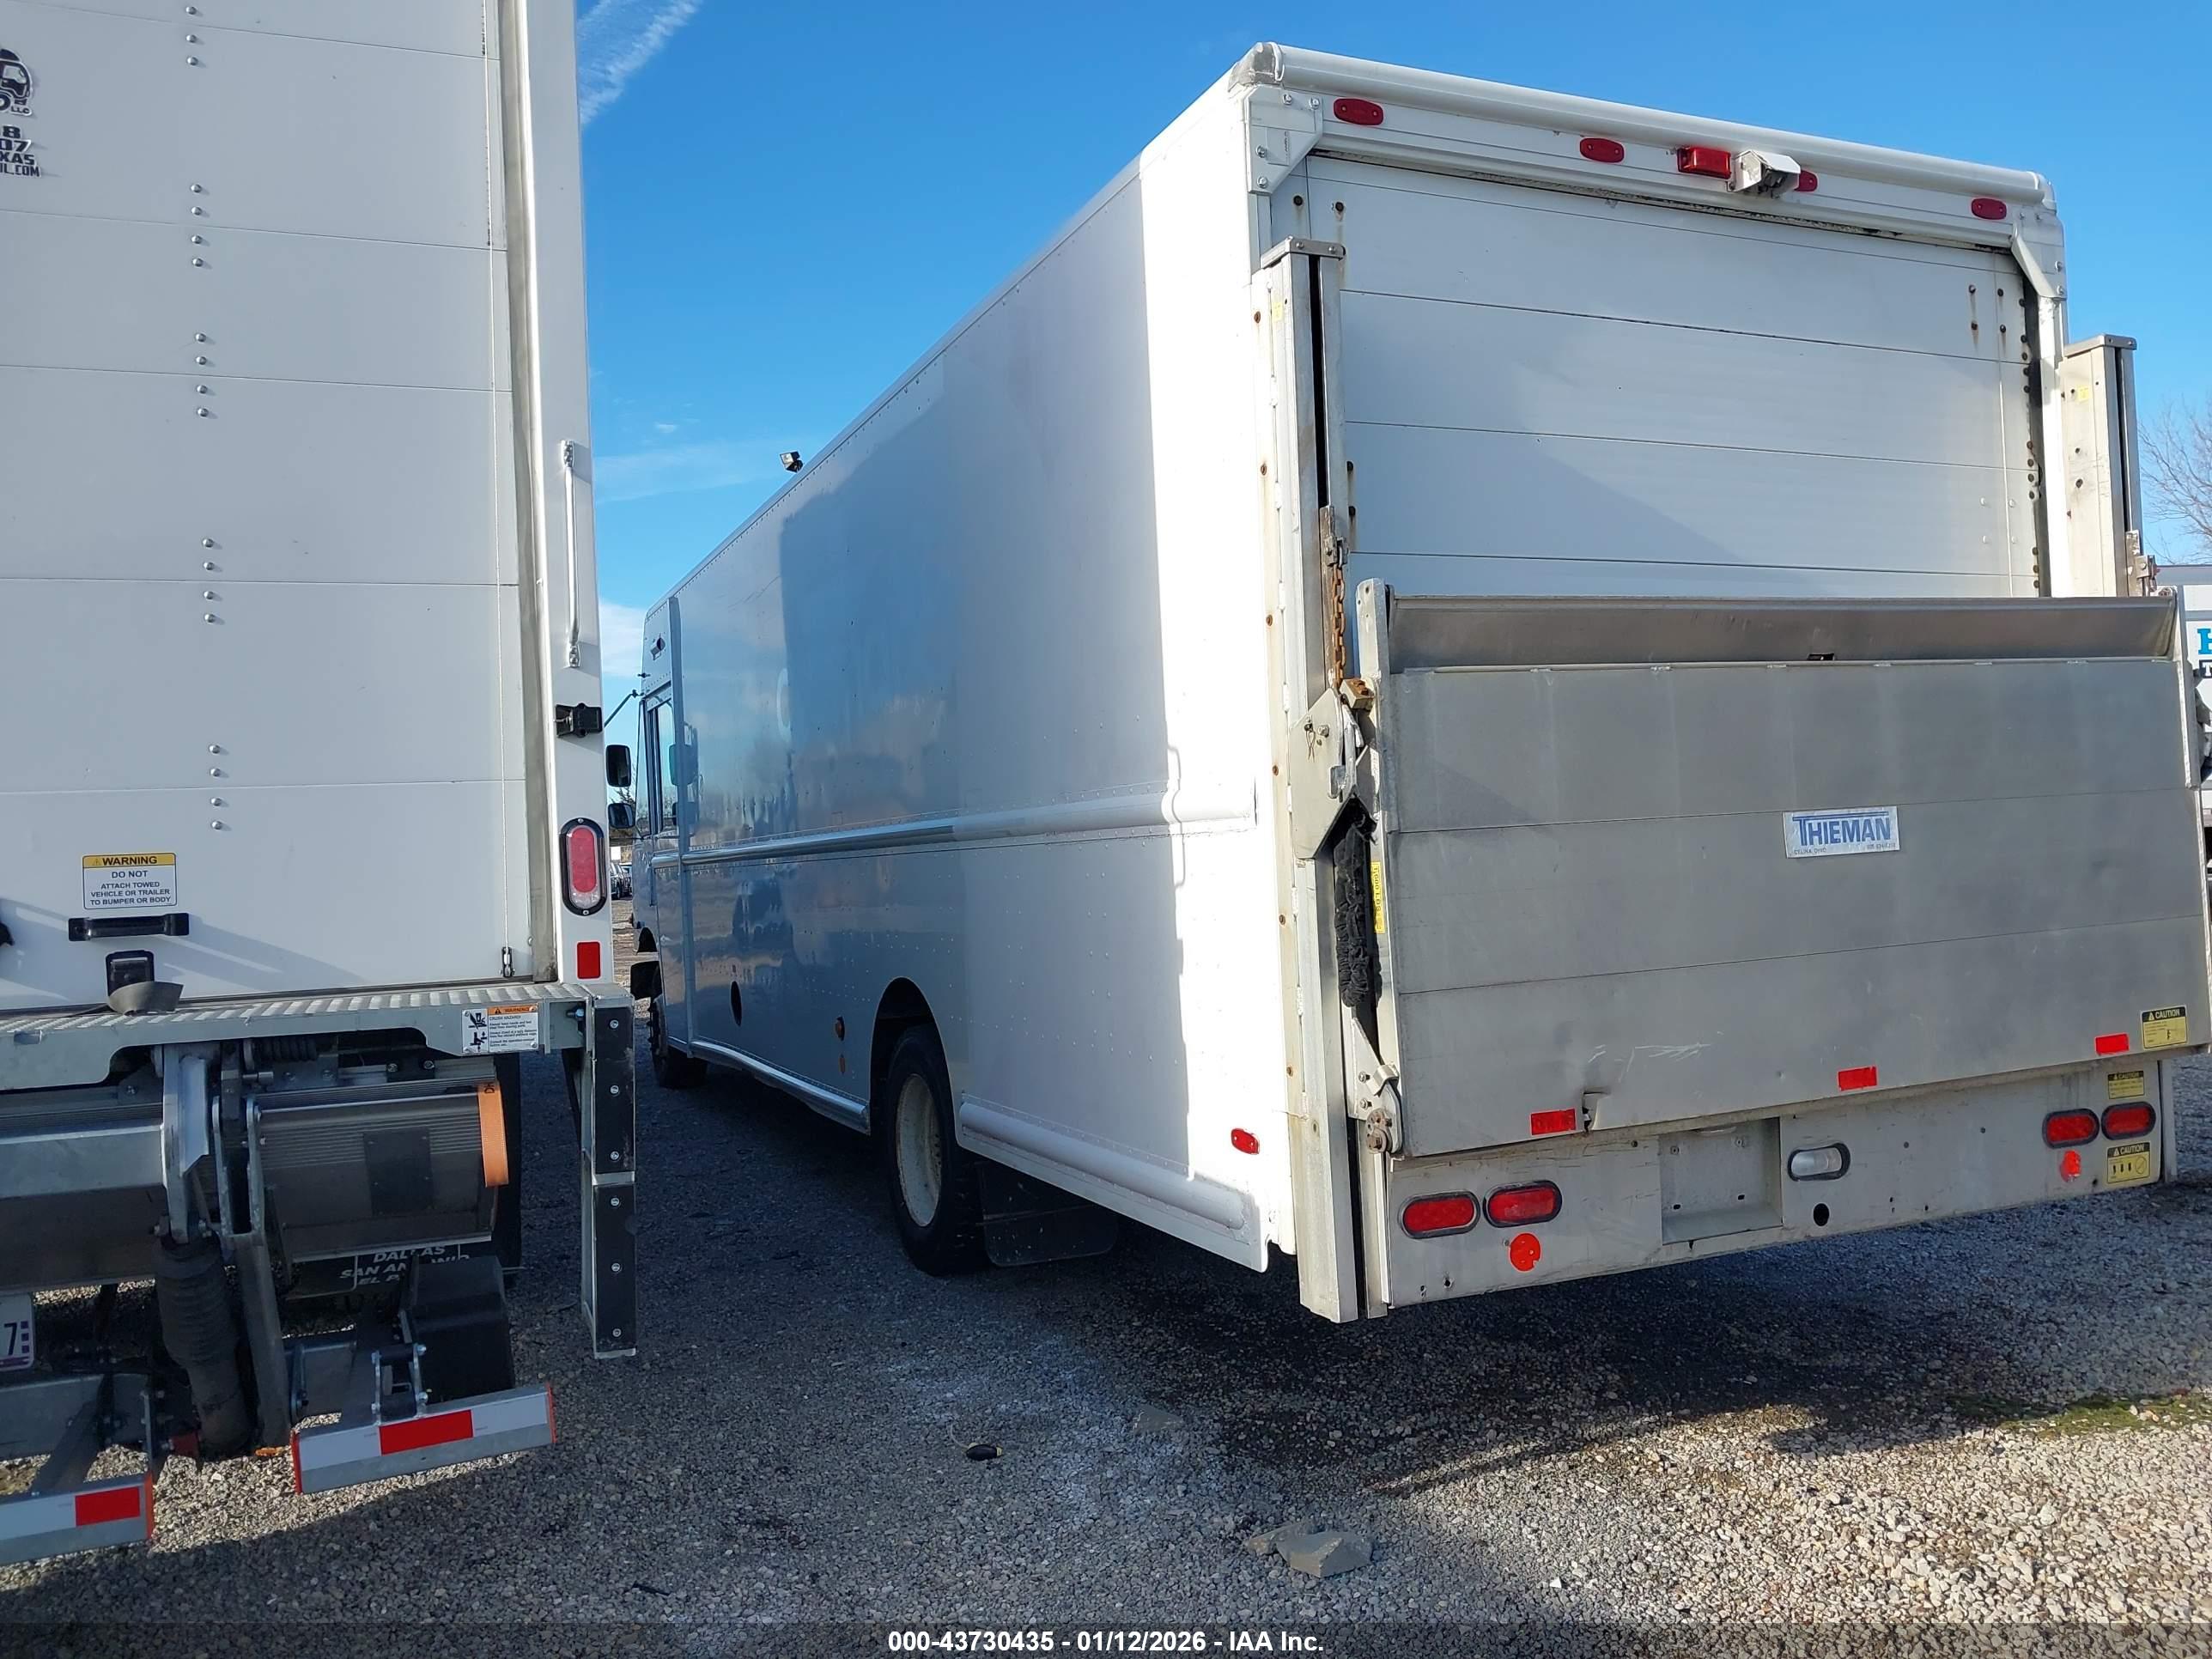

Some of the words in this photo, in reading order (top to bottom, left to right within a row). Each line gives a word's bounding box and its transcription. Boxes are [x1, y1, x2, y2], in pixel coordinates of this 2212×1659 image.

[10, 106, 30, 114] LLC
[1792, 811, 1892, 847] THIEMAN
[102, 855, 158, 866] WARNING
[2154, 1009, 2180, 1019] CAUTION
[2120, 1143, 2144, 1155] CAUTION
[340, 1266, 380, 1279] SAN
[3, 1322, 17, 1355] 7
